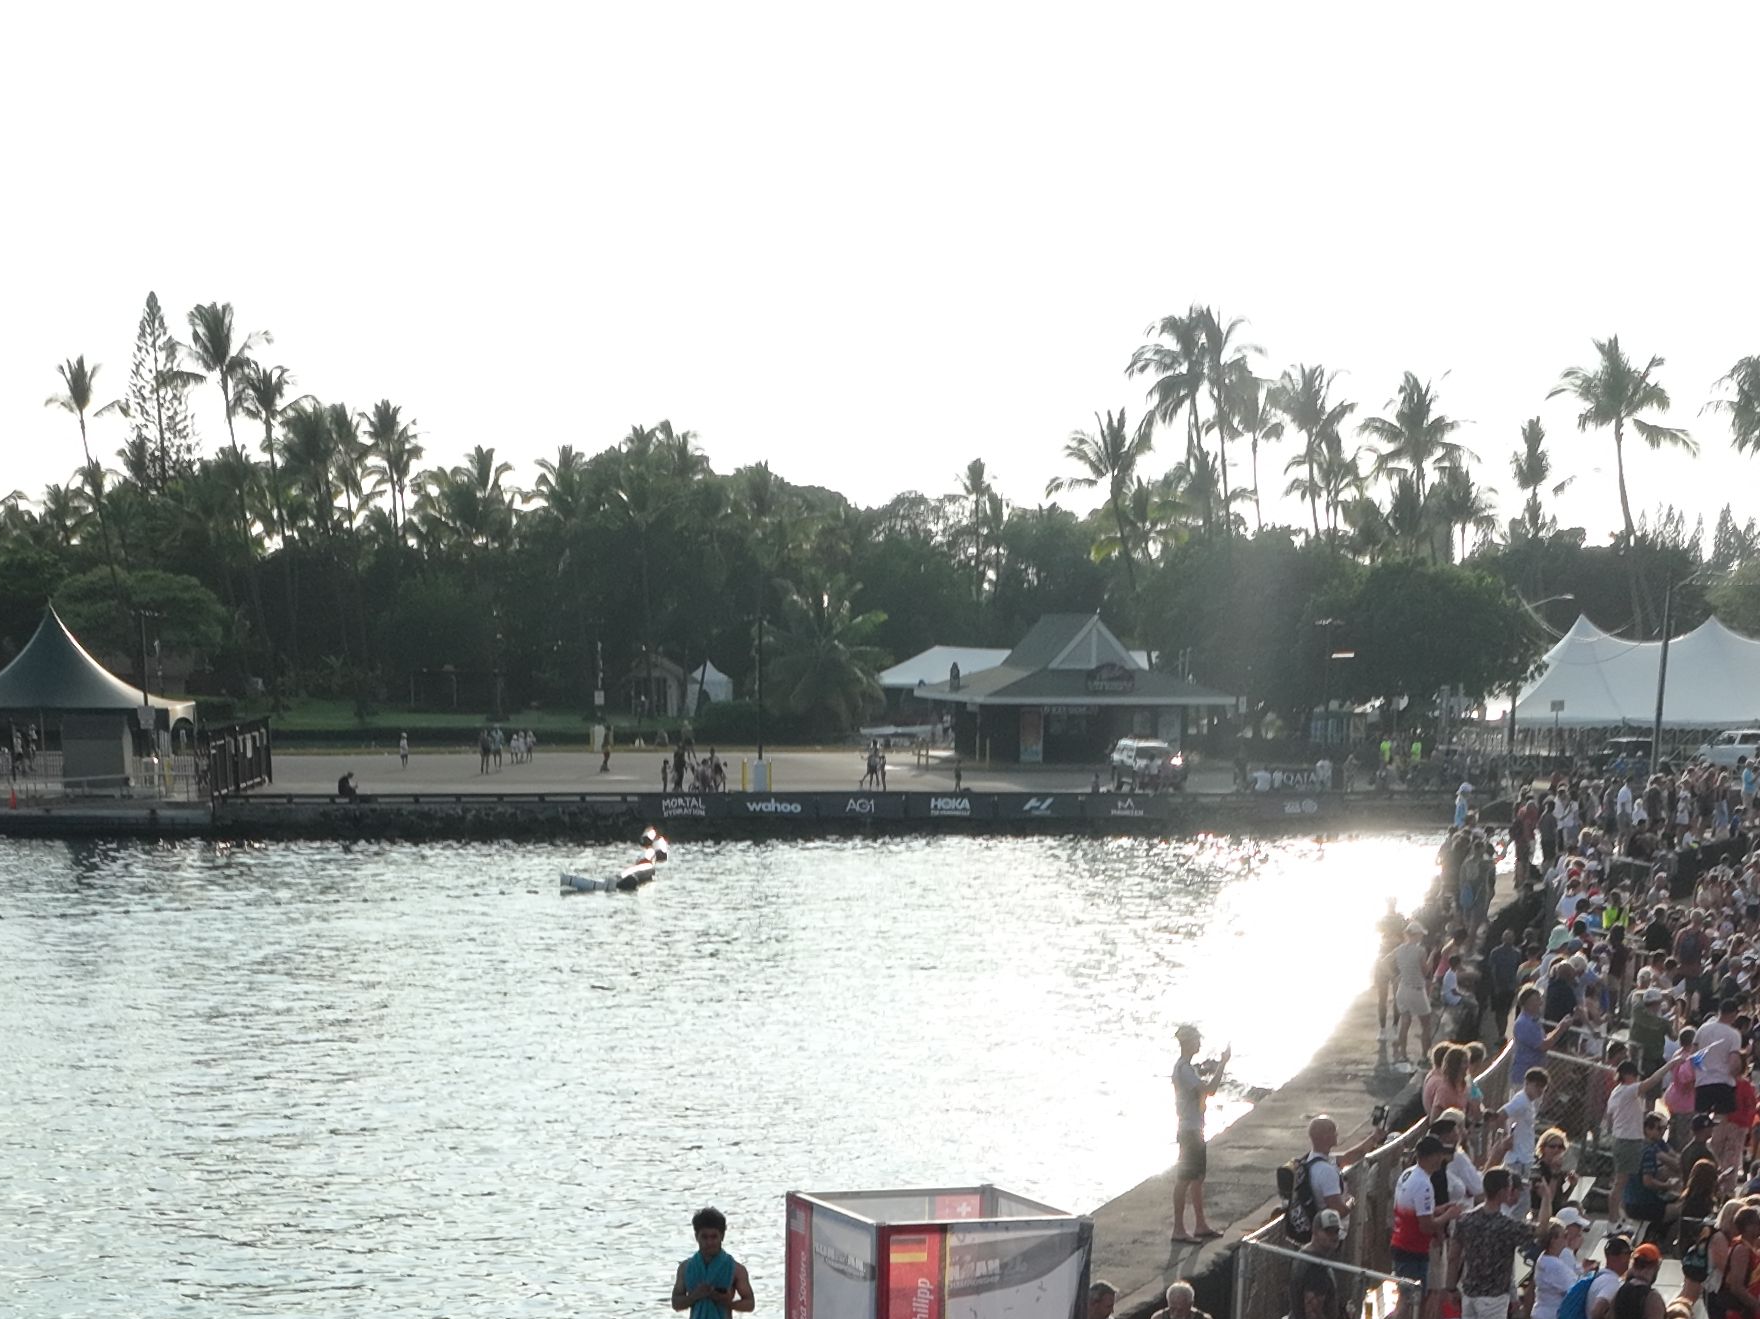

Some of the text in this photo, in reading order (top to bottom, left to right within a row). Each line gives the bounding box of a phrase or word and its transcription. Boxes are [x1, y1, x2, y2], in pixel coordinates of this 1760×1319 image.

[662, 797, 706, 809] MORTAL
[747, 800, 802, 813] wahoo
[846, 798, 875, 813] AG1
[930, 798, 971, 810] HOKA
